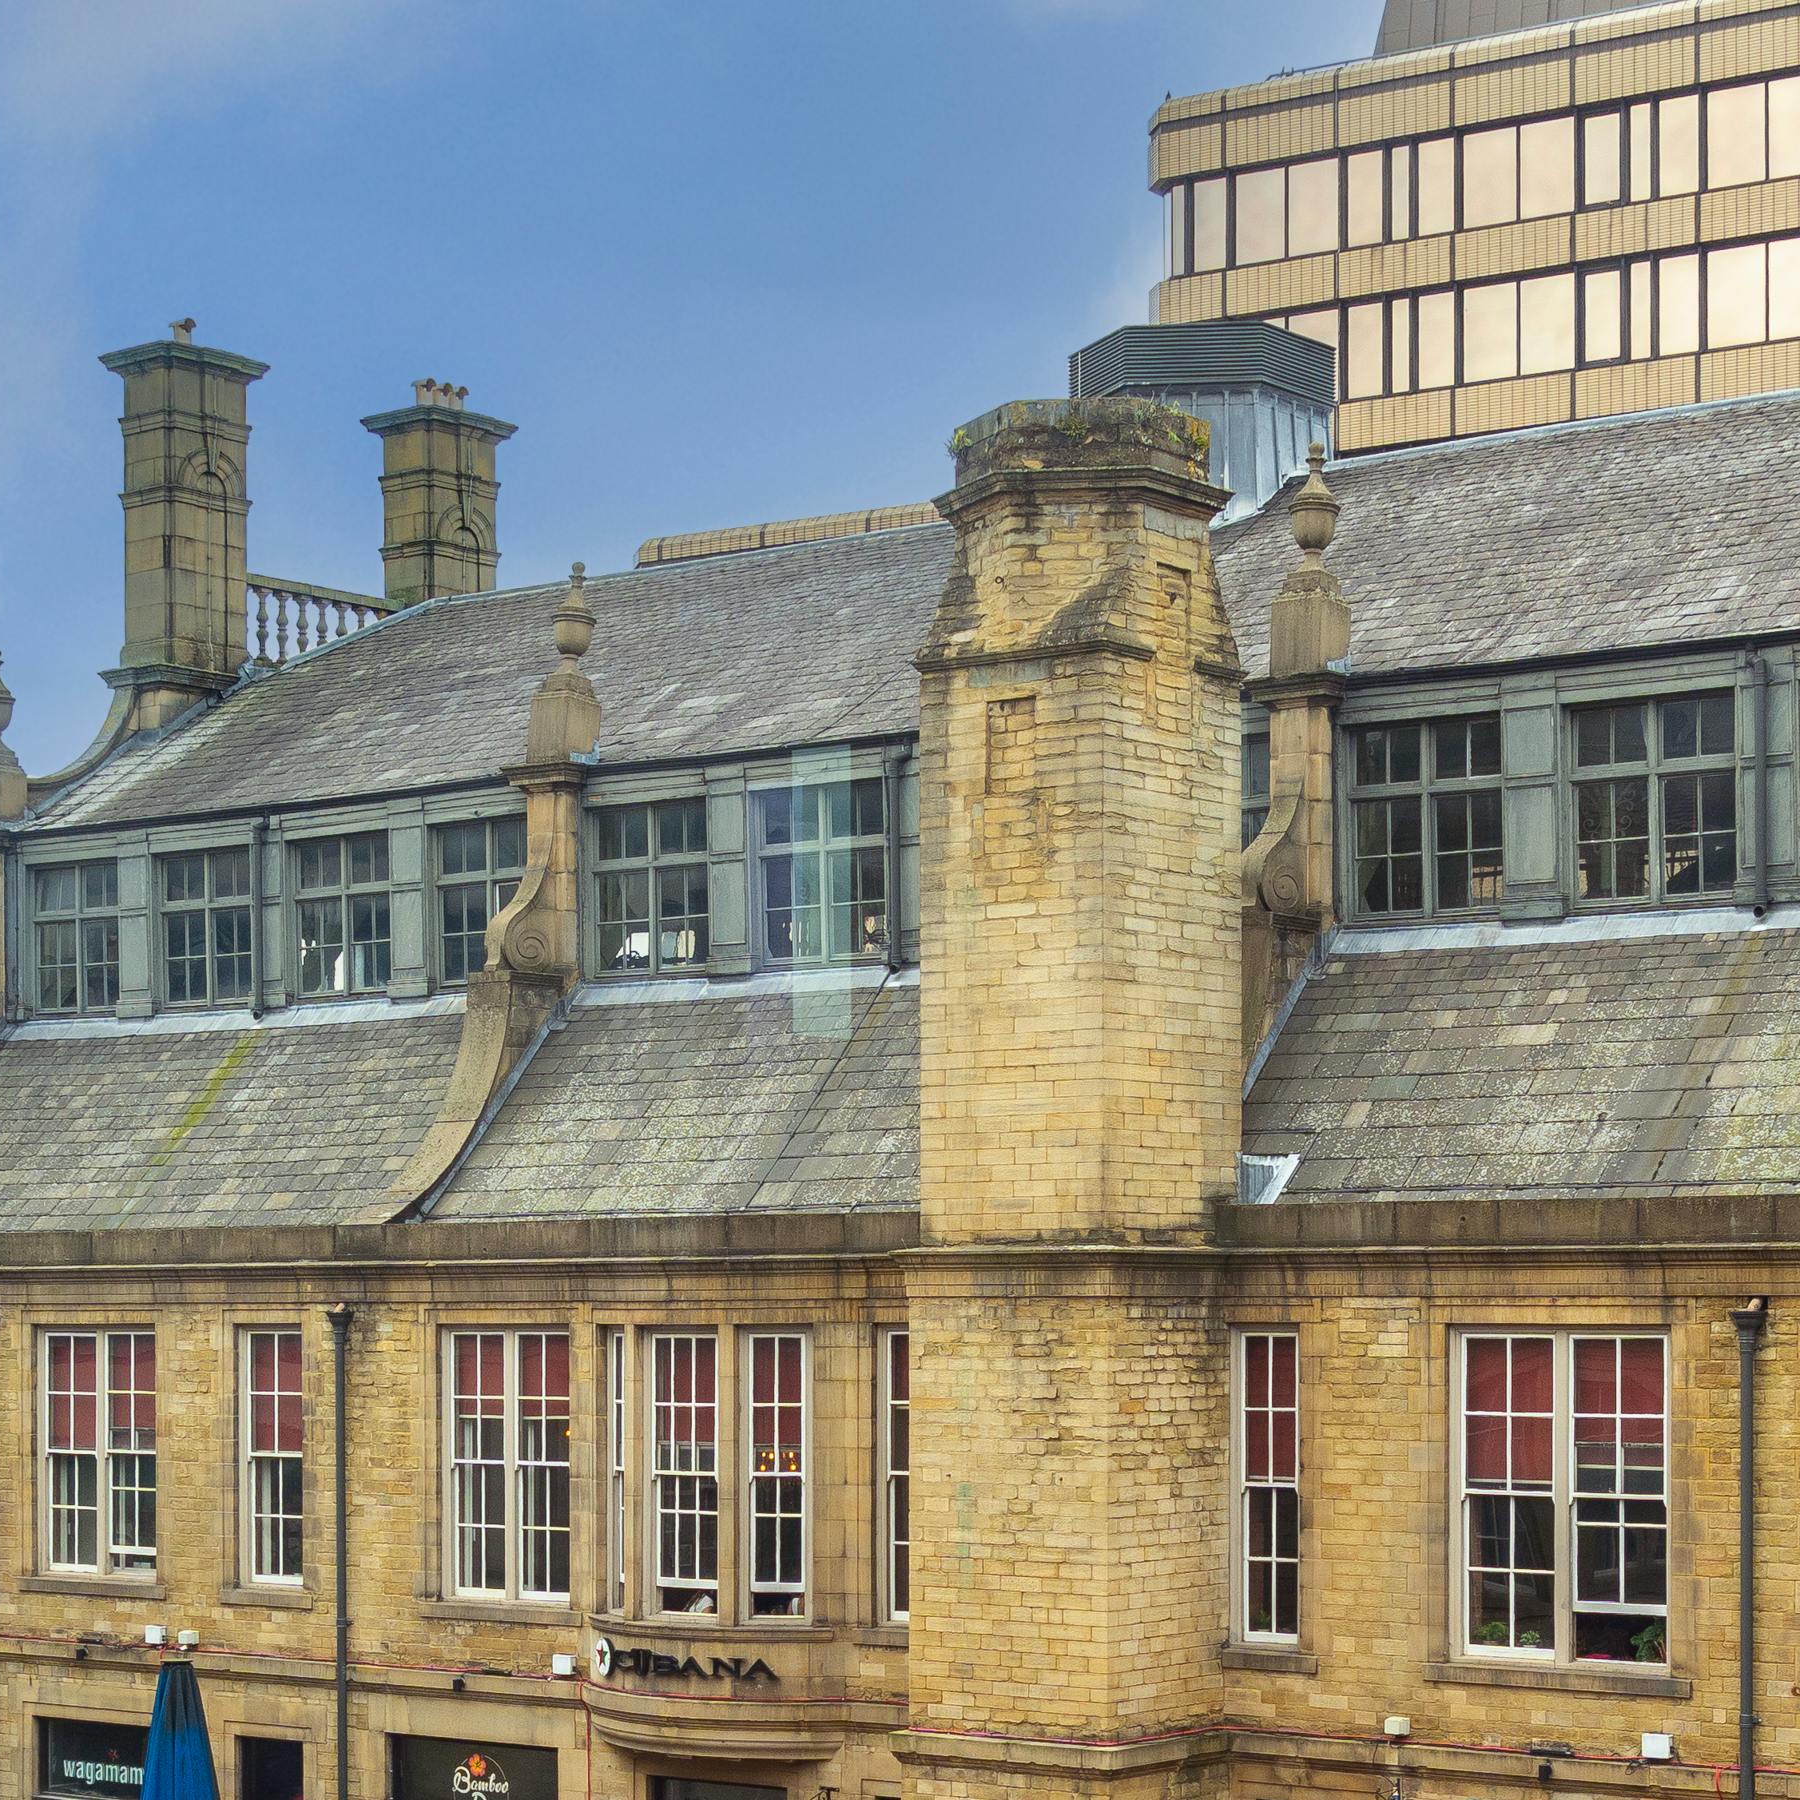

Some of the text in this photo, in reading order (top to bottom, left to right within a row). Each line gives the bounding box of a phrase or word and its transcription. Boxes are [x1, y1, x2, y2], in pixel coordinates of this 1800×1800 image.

[614, 1648, 780, 1680] CUBANA
[63, 1757, 144, 1785] wagamam
[452, 1766, 509, 1793] Bamboo
